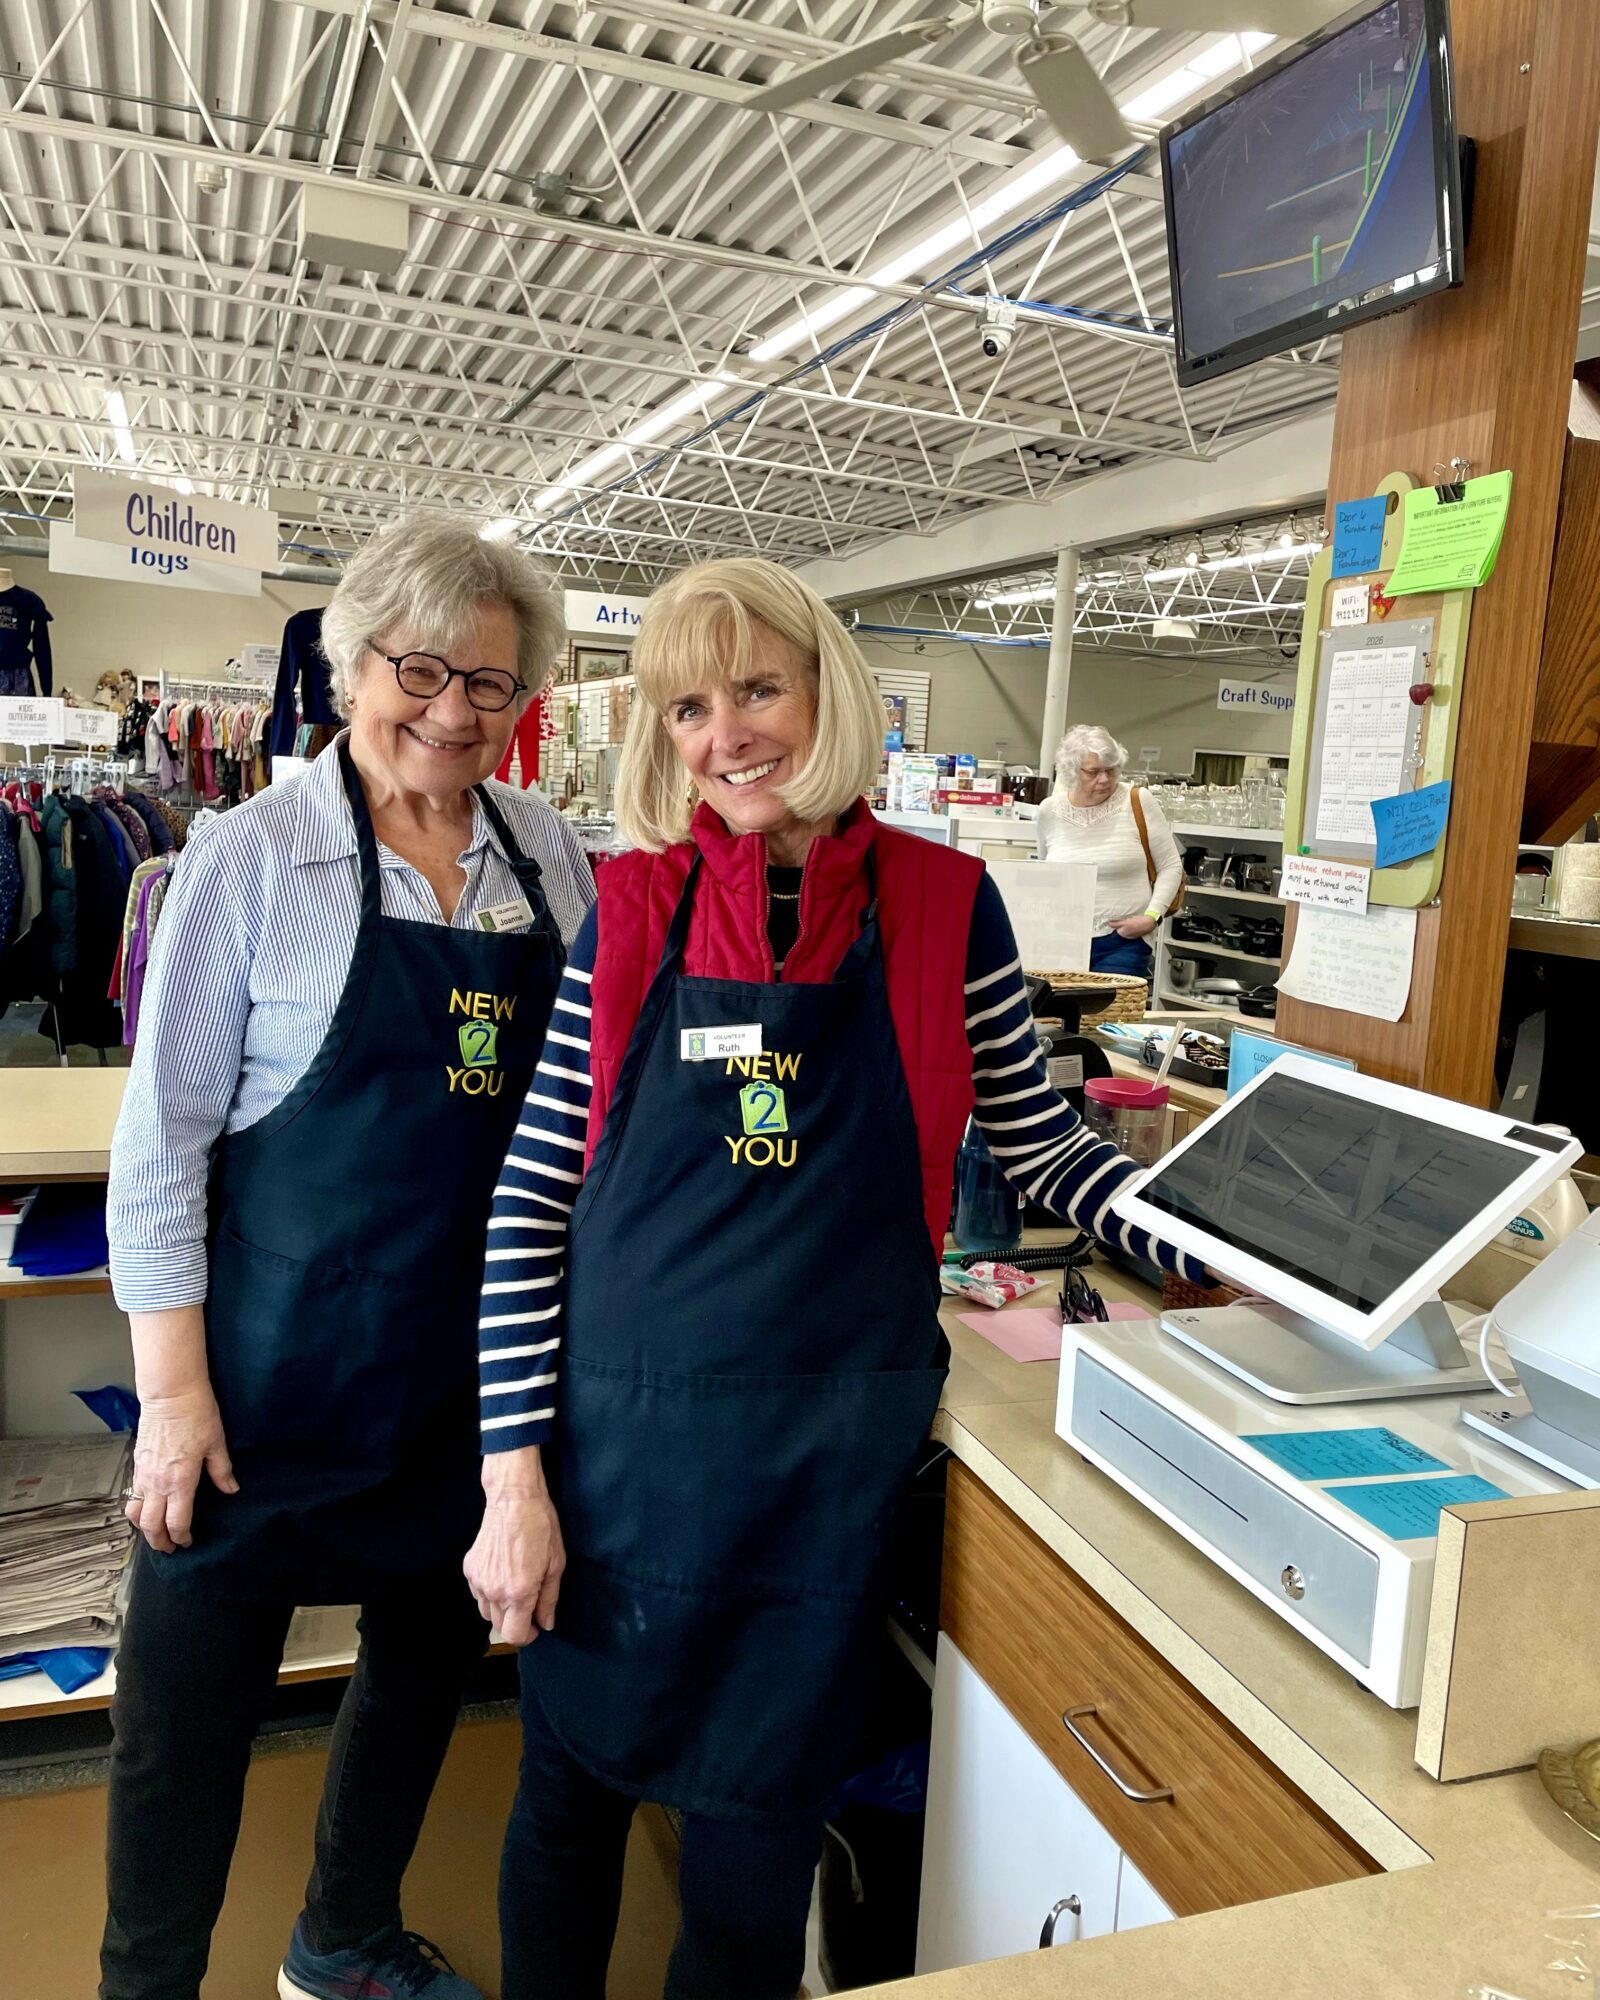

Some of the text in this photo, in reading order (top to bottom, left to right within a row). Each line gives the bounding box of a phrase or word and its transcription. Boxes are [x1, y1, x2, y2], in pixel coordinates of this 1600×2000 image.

[126, 492, 236, 554] Children
[1365, 636, 1384, 646] 2026
[1221, 688, 1256, 702] Craft
[8, 712, 47, 722] OUTERWEAR
[1288, 861, 1318, 874] Electronic
[1304, 877, 1311, 886] be
[1313, 877, 1340, 890] returned
[499, 914, 524, 926] Joanne
[449, 988, 517, 1021] NEW
[467, 1027, 493, 1062] 2
[718, 1043, 741, 1053] Ruth
[725, 1051, 803, 1081] NEW
[445, 1065, 505, 1097] YOU
[749, 1090, 781, 1129] 2
[724, 1135, 798, 1167] YOU
